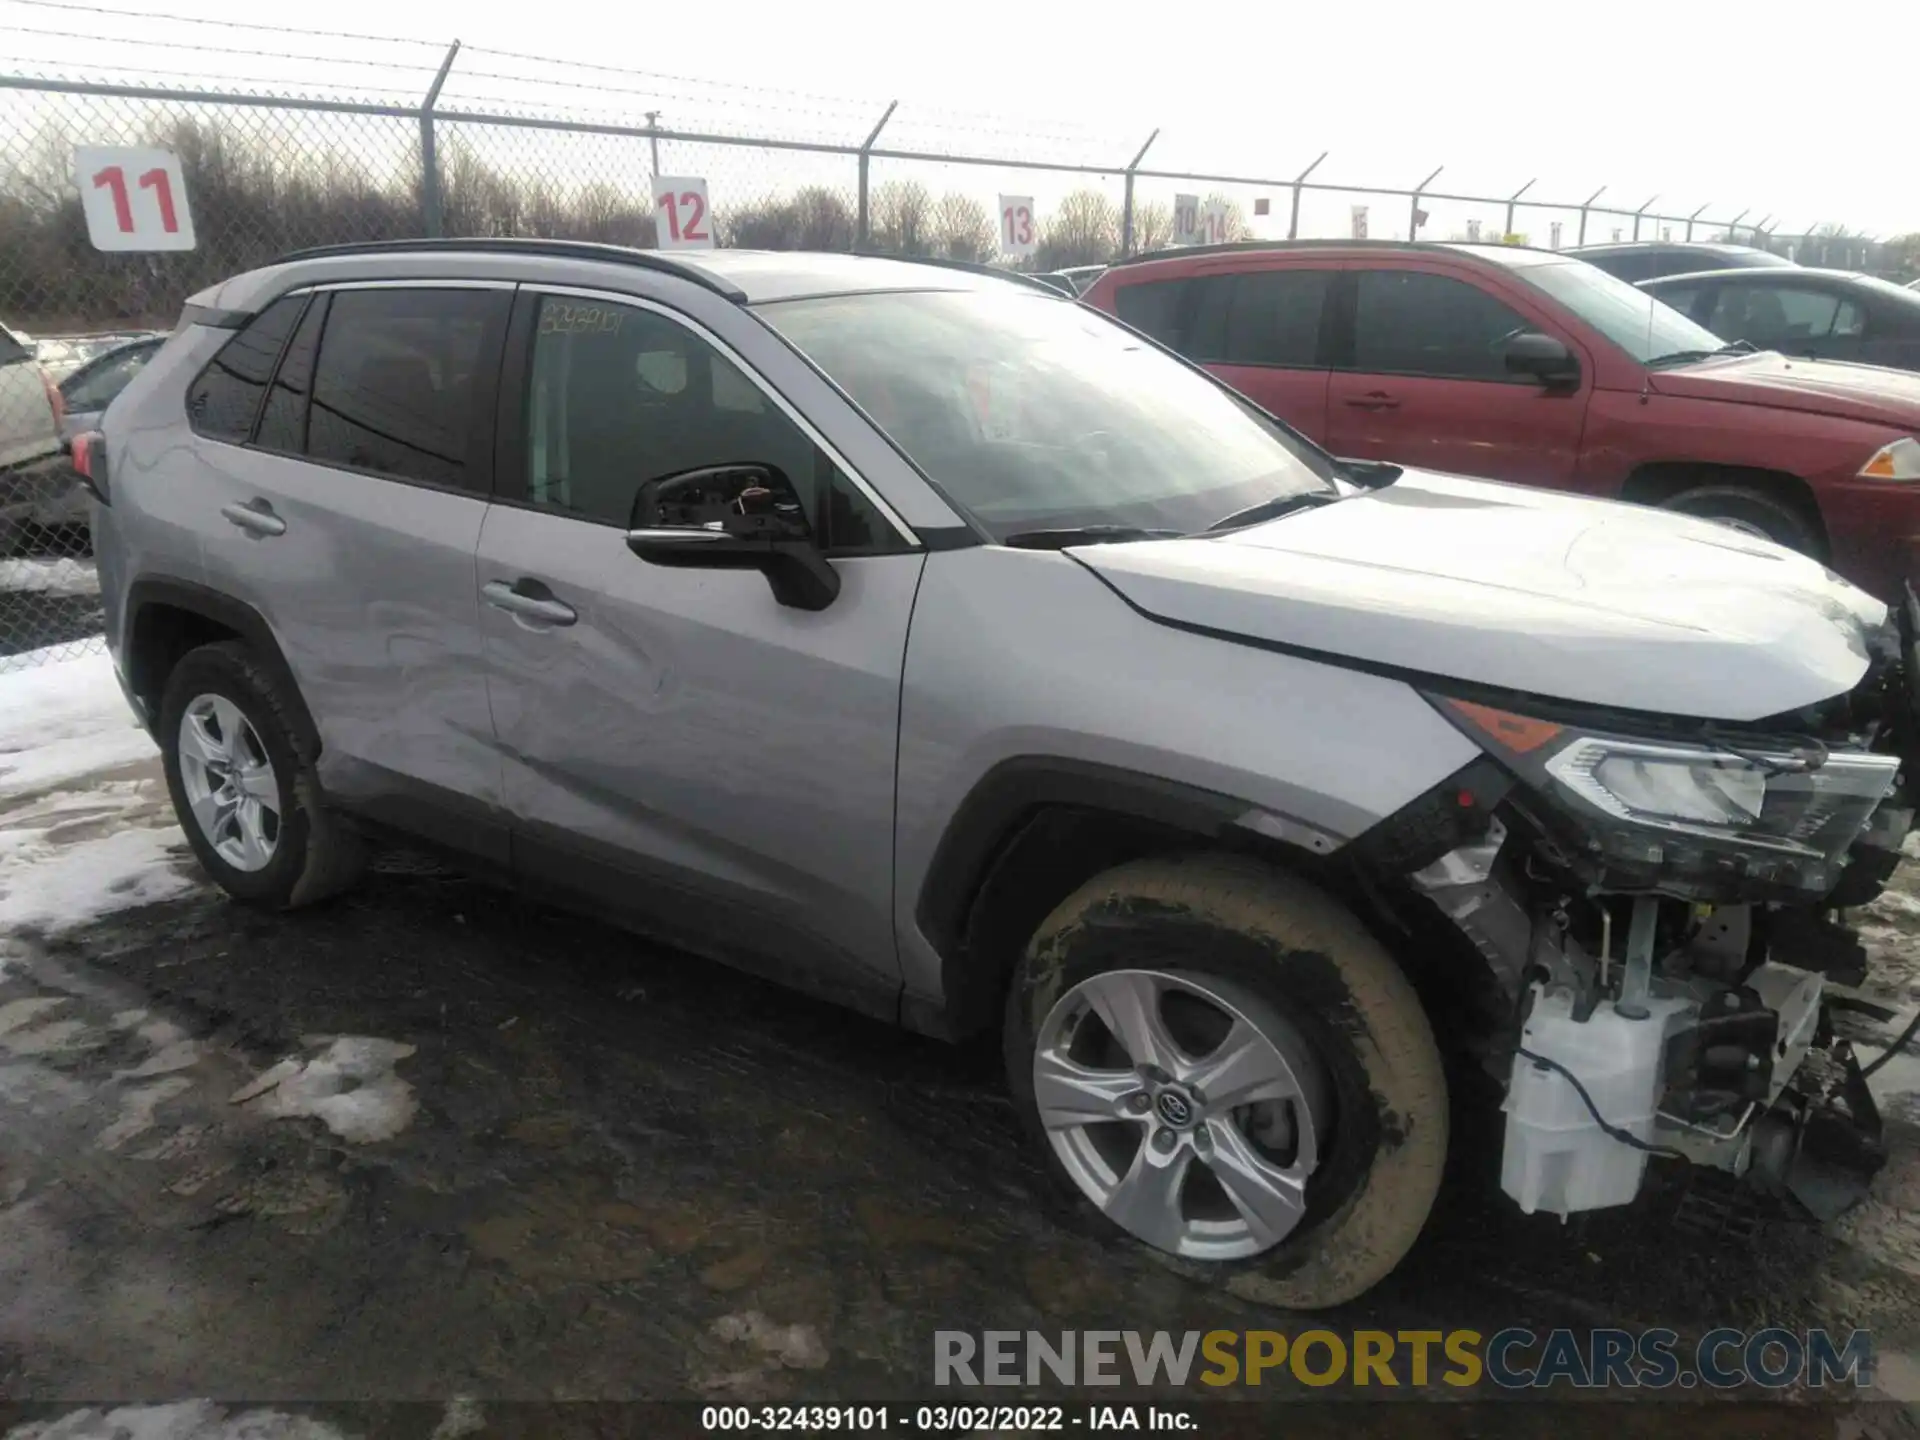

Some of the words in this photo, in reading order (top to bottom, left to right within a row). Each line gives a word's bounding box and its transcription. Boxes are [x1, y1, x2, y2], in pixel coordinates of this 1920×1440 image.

[91, 165, 179, 233] 11
[657, 191, 709, 241] 12
[1003, 205, 1032, 245] 13
